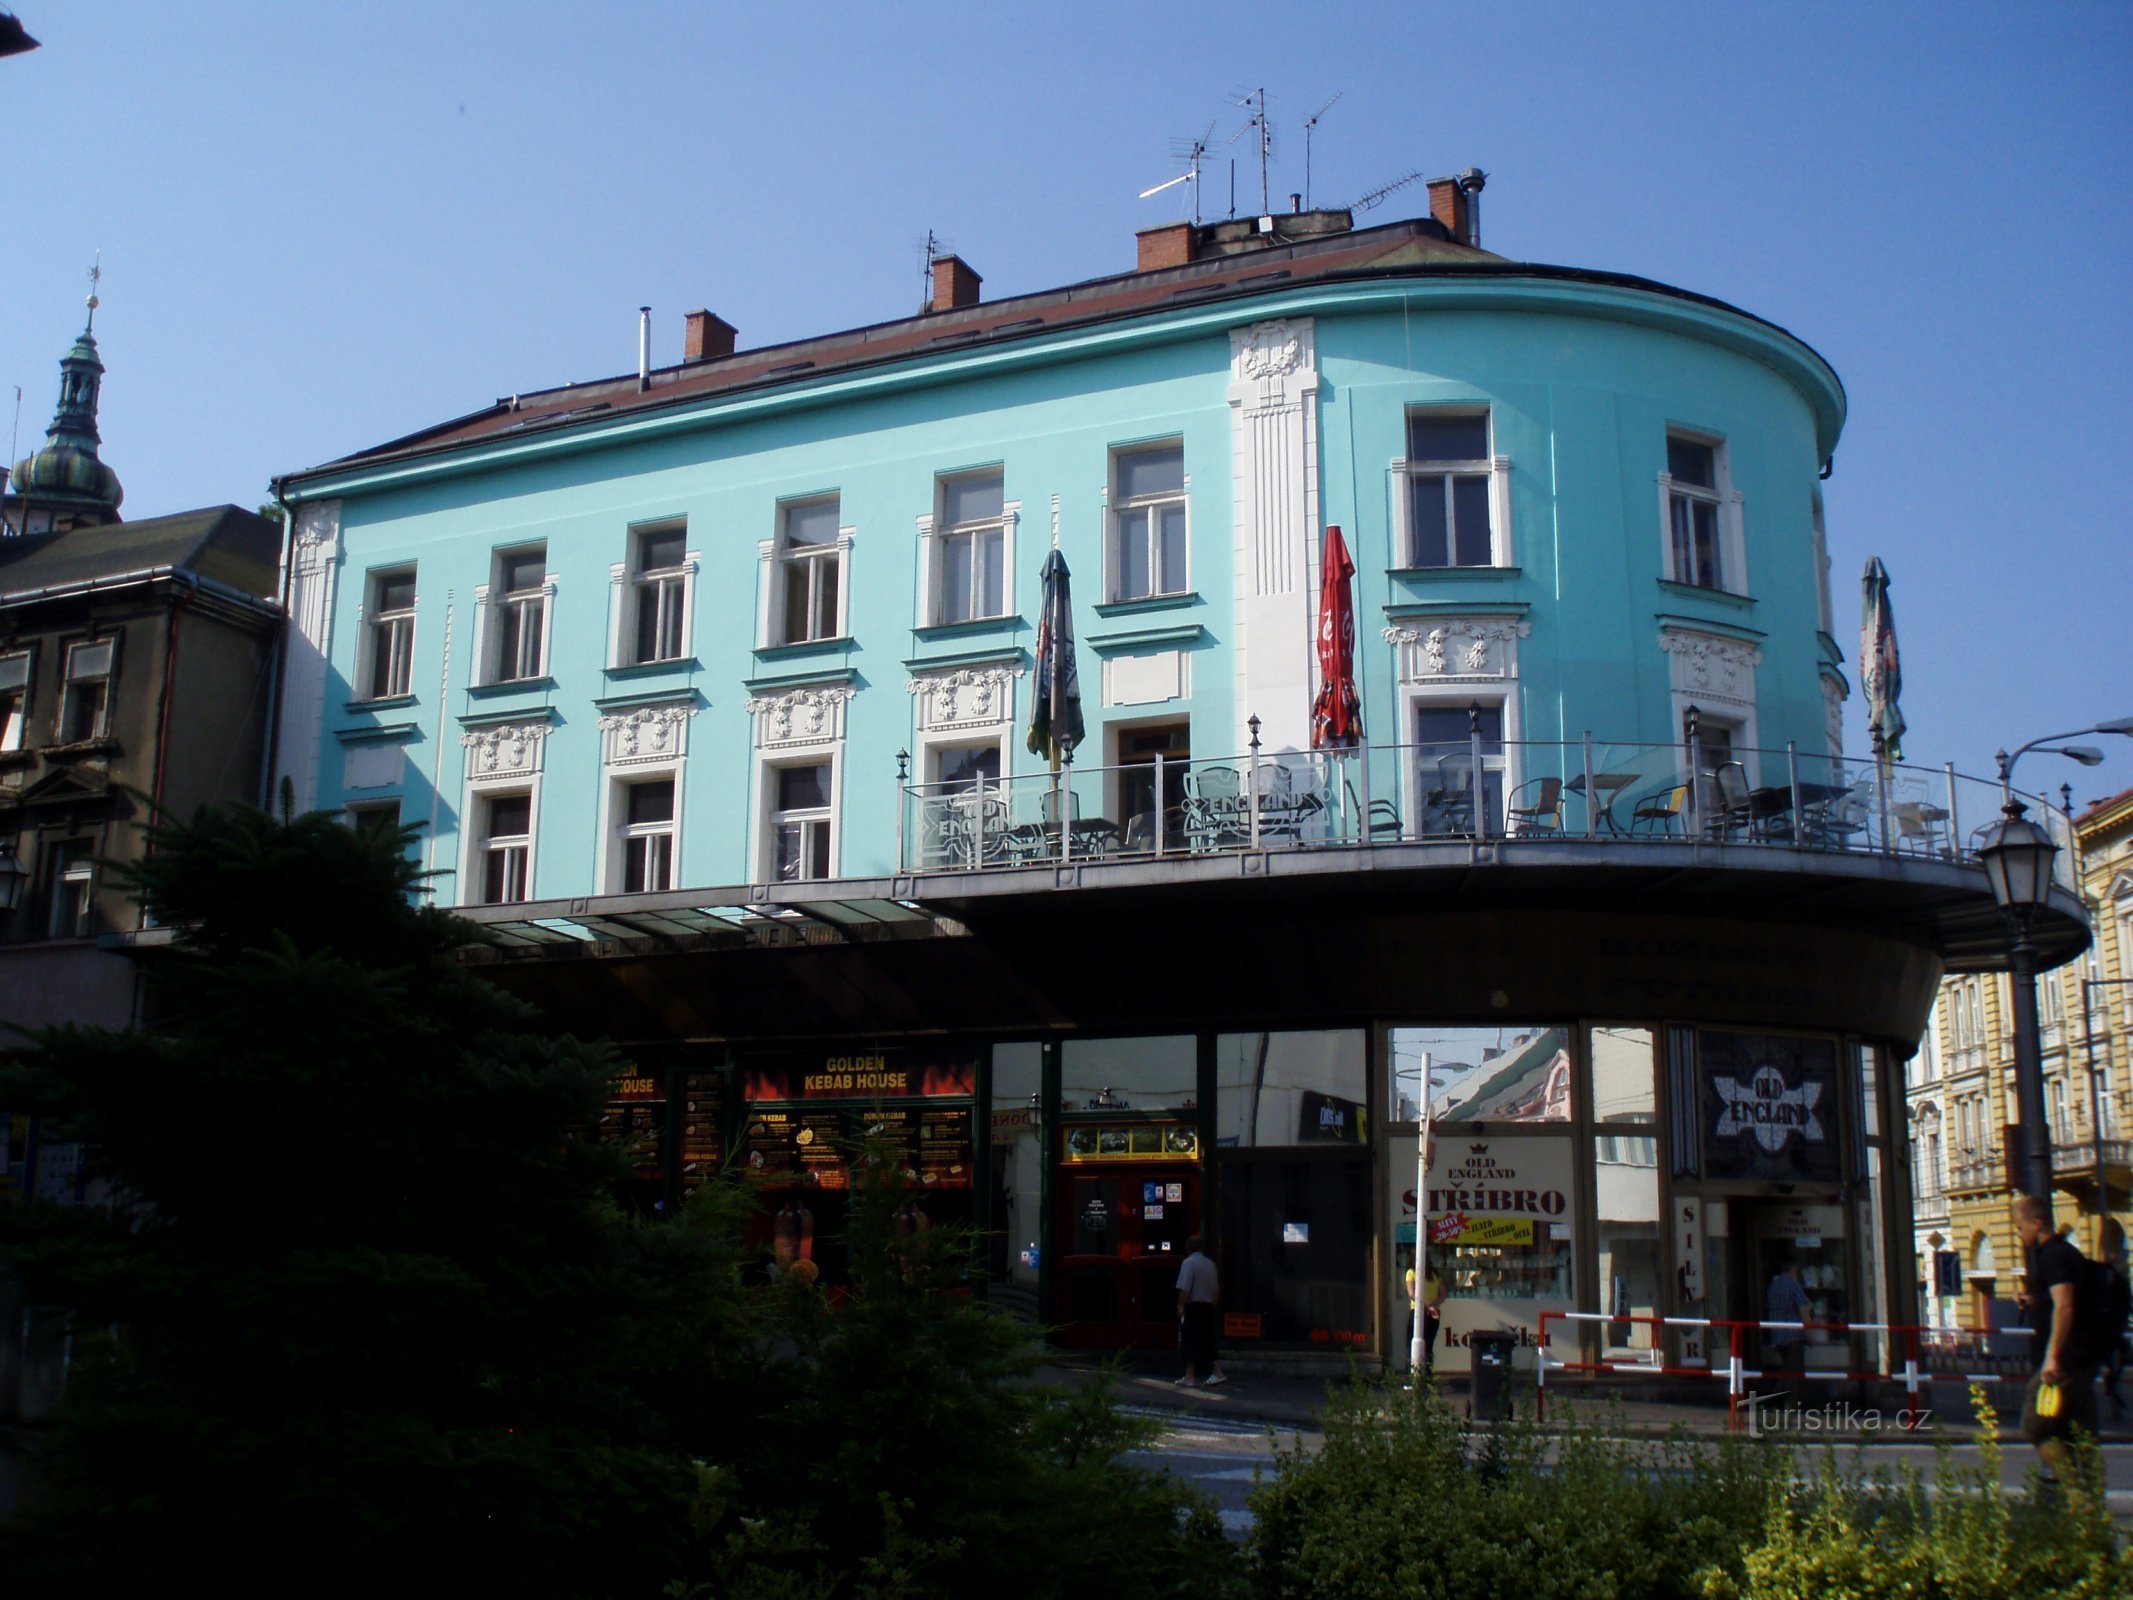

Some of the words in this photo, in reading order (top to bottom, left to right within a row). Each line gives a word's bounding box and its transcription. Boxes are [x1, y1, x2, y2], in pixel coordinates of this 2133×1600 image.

[964, 799, 997, 817] OD
[1210, 793, 1303, 813] ENGAND
[827, 1056, 884, 1072] GOLDEN
[805, 1075, 852, 1090] KEBAB
[857, 1073, 906, 1088] HOUSE
[1755, 1077, 1783, 1099] OLD
[1731, 1100, 1810, 1125] ENGLAND
[1465, 1157, 1496, 1168] OLD
[1448, 1169, 1516, 1179] ENGLAND
[1402, 1181, 1566, 1216] STŘÍBRO
